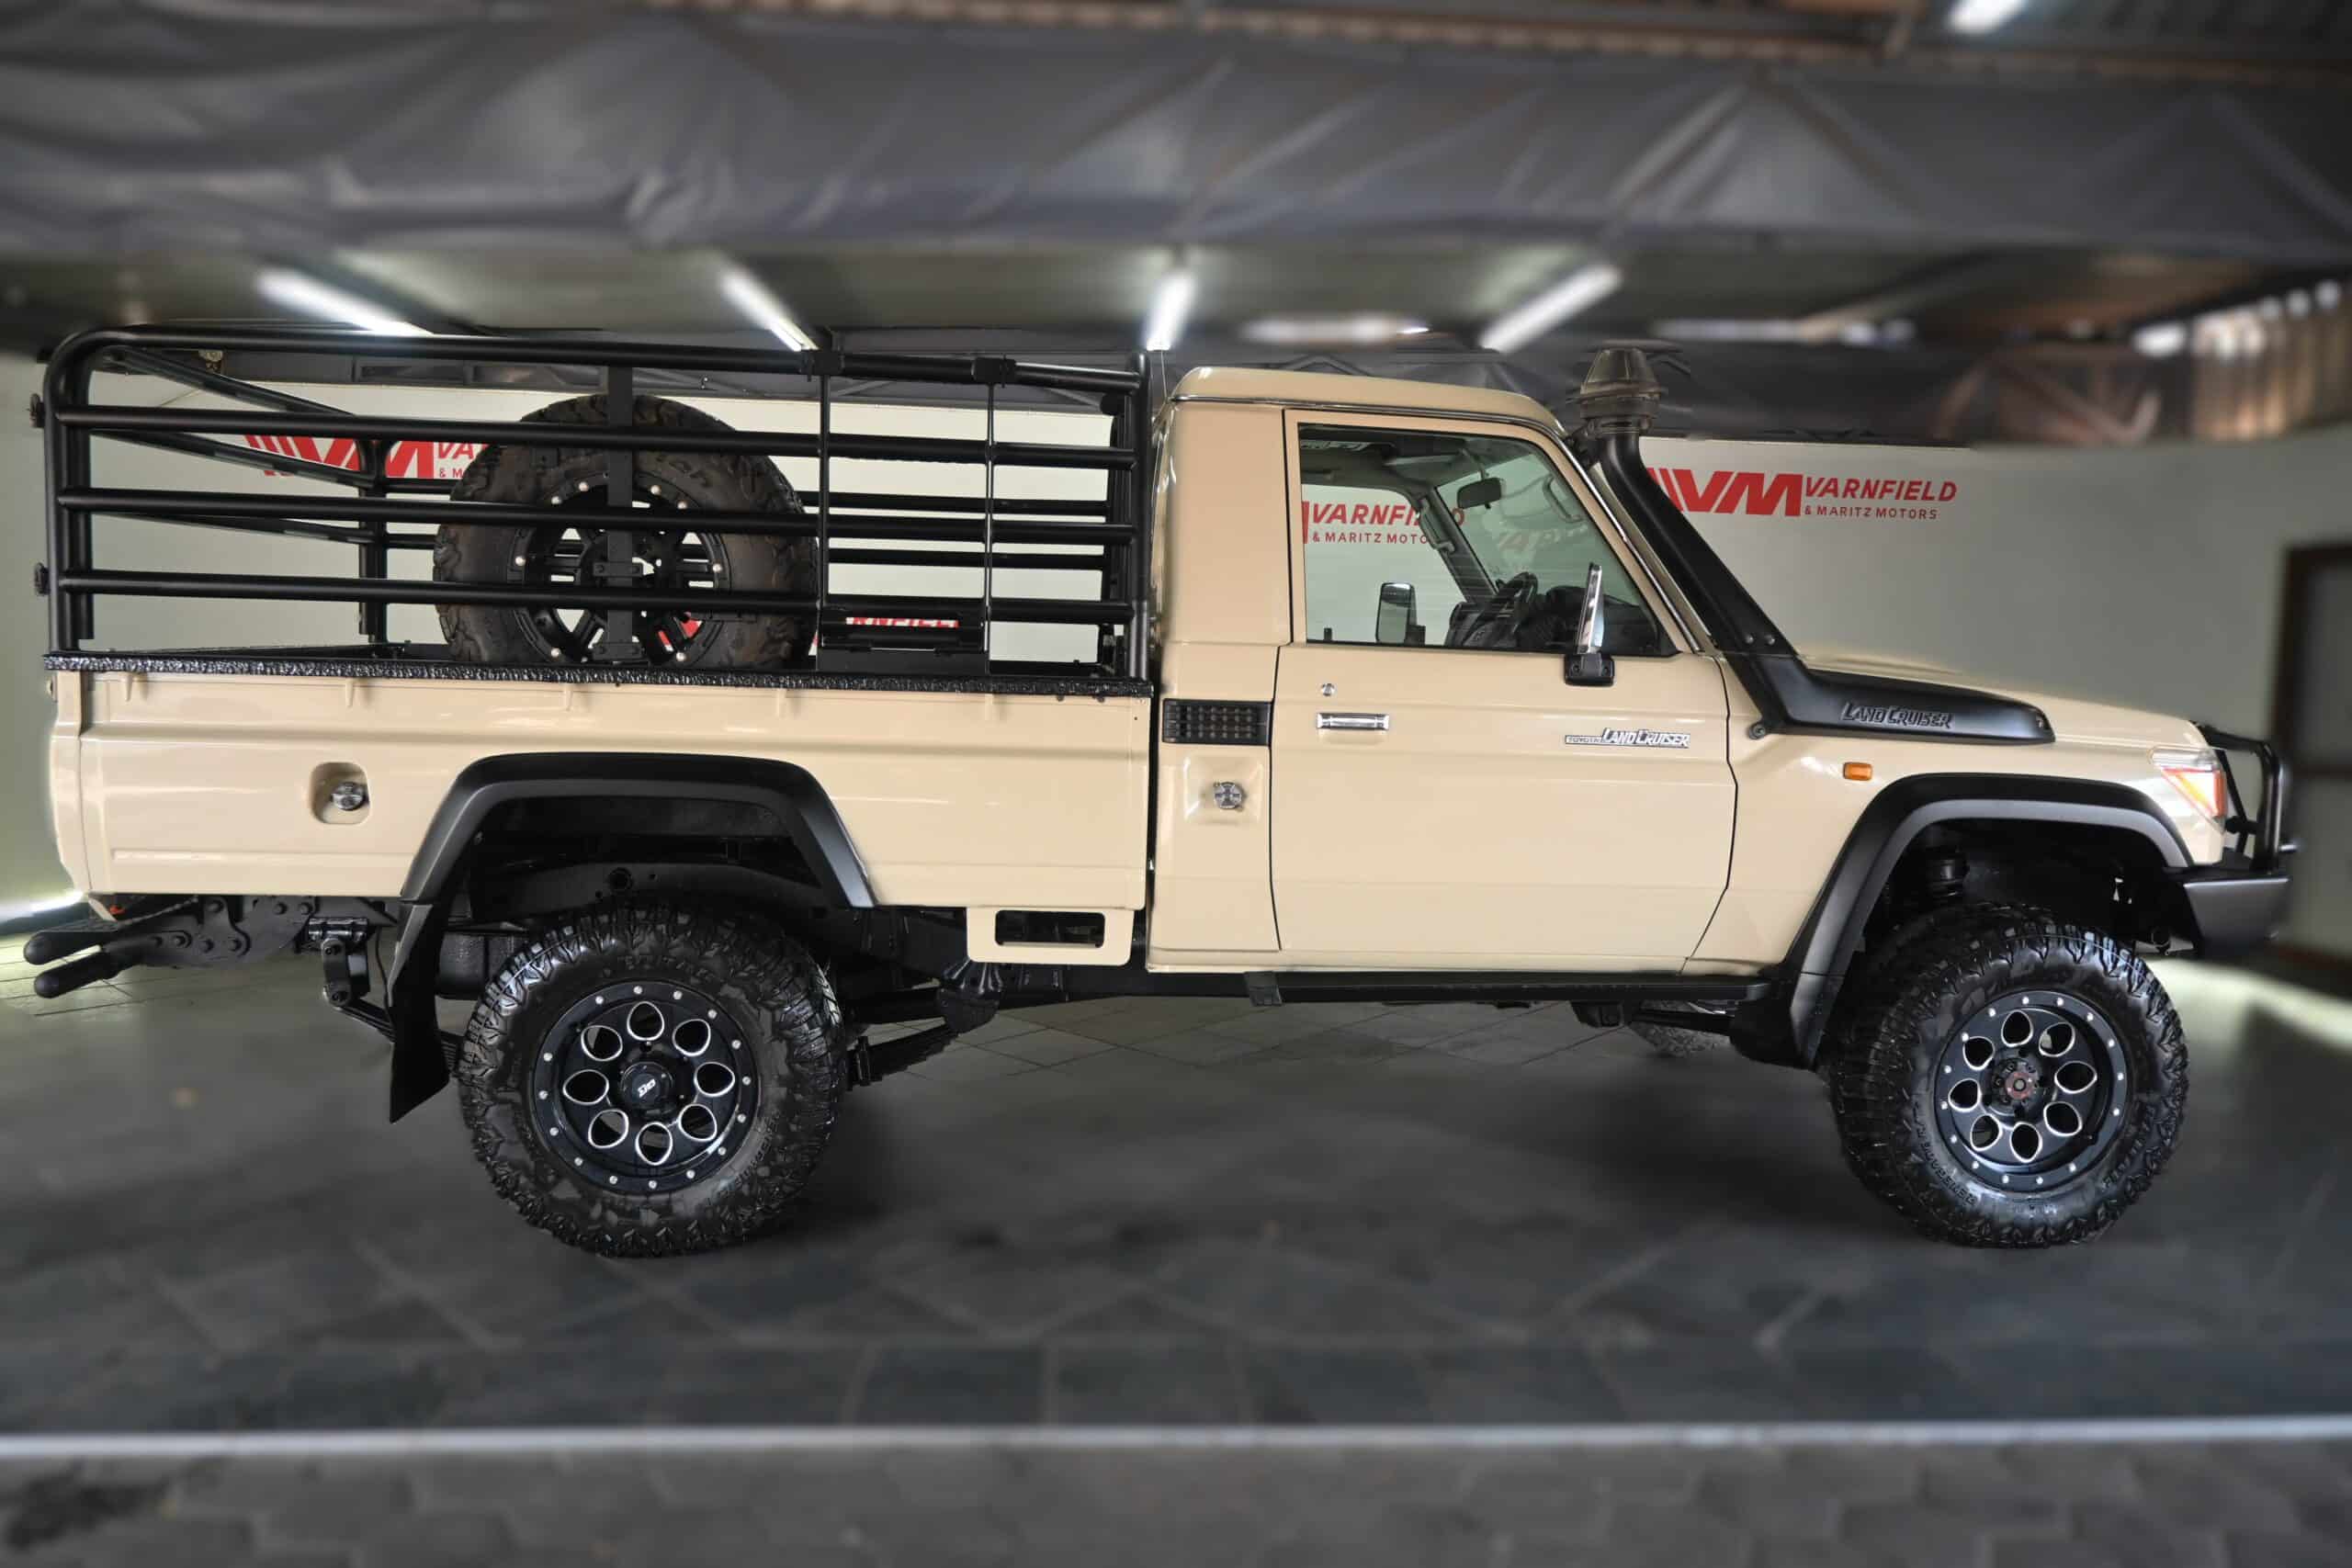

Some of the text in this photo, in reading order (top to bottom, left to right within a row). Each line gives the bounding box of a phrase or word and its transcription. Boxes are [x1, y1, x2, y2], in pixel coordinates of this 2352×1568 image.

[1804, 476, 1958, 502] VARNFIELD
[1804, 505, 1939, 520] & MARITZ MOTORS
[1312, 532, 1430, 544] & MARITZ MOTO
[1840, 702, 1955, 729] LAND CRUISER
[1602, 728, 1636, 744] LAND
[1635, 729, 1690, 748] CRUISER
